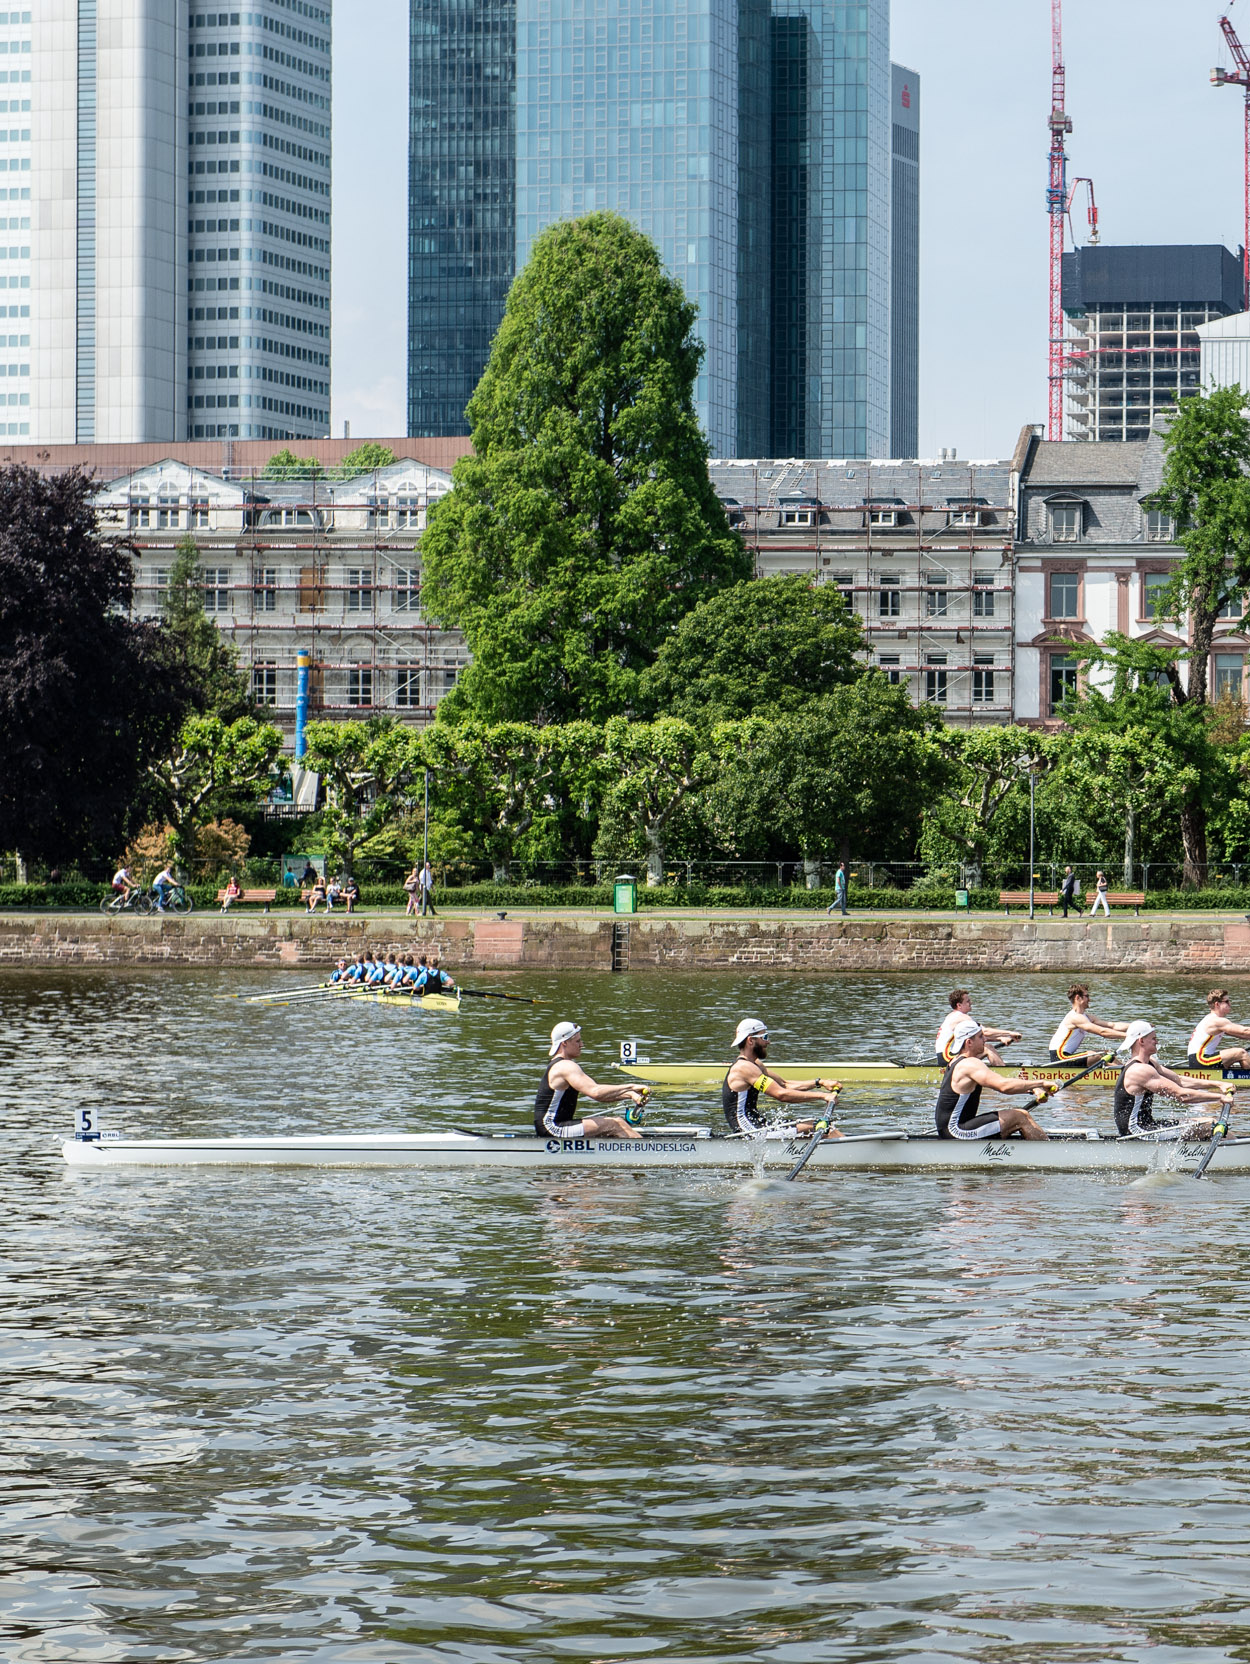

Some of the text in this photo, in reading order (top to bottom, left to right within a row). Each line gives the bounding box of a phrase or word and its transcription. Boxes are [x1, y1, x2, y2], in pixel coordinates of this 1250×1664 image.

[624, 1043, 632, 1056] 8
[1032, 1070, 1090, 1081] Sparkase
[82, 1110, 92, 1131] 5
[563, 1140, 595, 1150] RBL
[598, 1142, 696, 1152] RUDER-BUNDESLIGA
